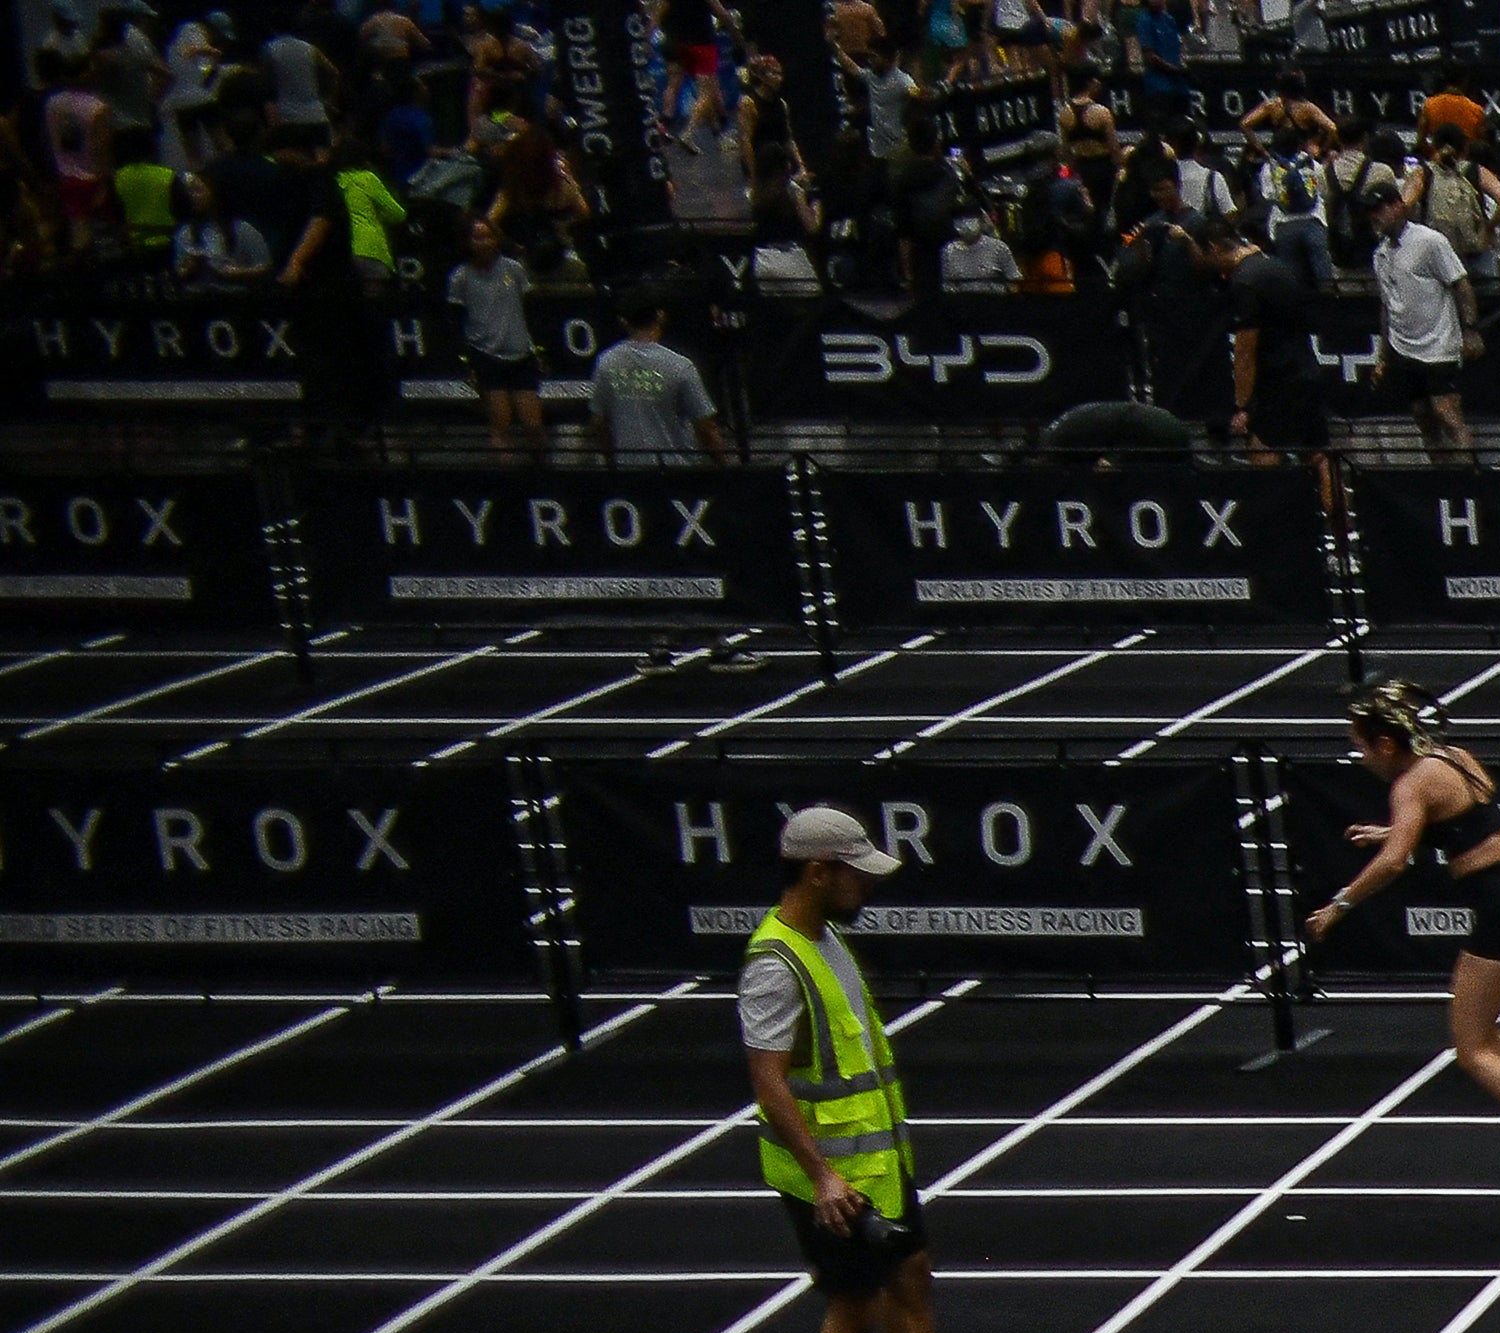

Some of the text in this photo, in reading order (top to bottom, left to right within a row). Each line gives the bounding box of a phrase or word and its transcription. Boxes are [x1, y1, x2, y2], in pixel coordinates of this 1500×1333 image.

[33, 319, 297, 358] HYROX
[821, 334, 1051, 383] BYD
[0, 496, 183, 546] ROX
[381, 499, 716, 547] HYROX
[906, 500, 1242, 549] HYROX
[0, 807, 410, 872] YROX
[677, 802, 1132, 866] HROX
[887, 910, 914, 930] OF
[922, 910, 1032, 930] FITNESS
[1042, 910, 1136, 930] RACING
